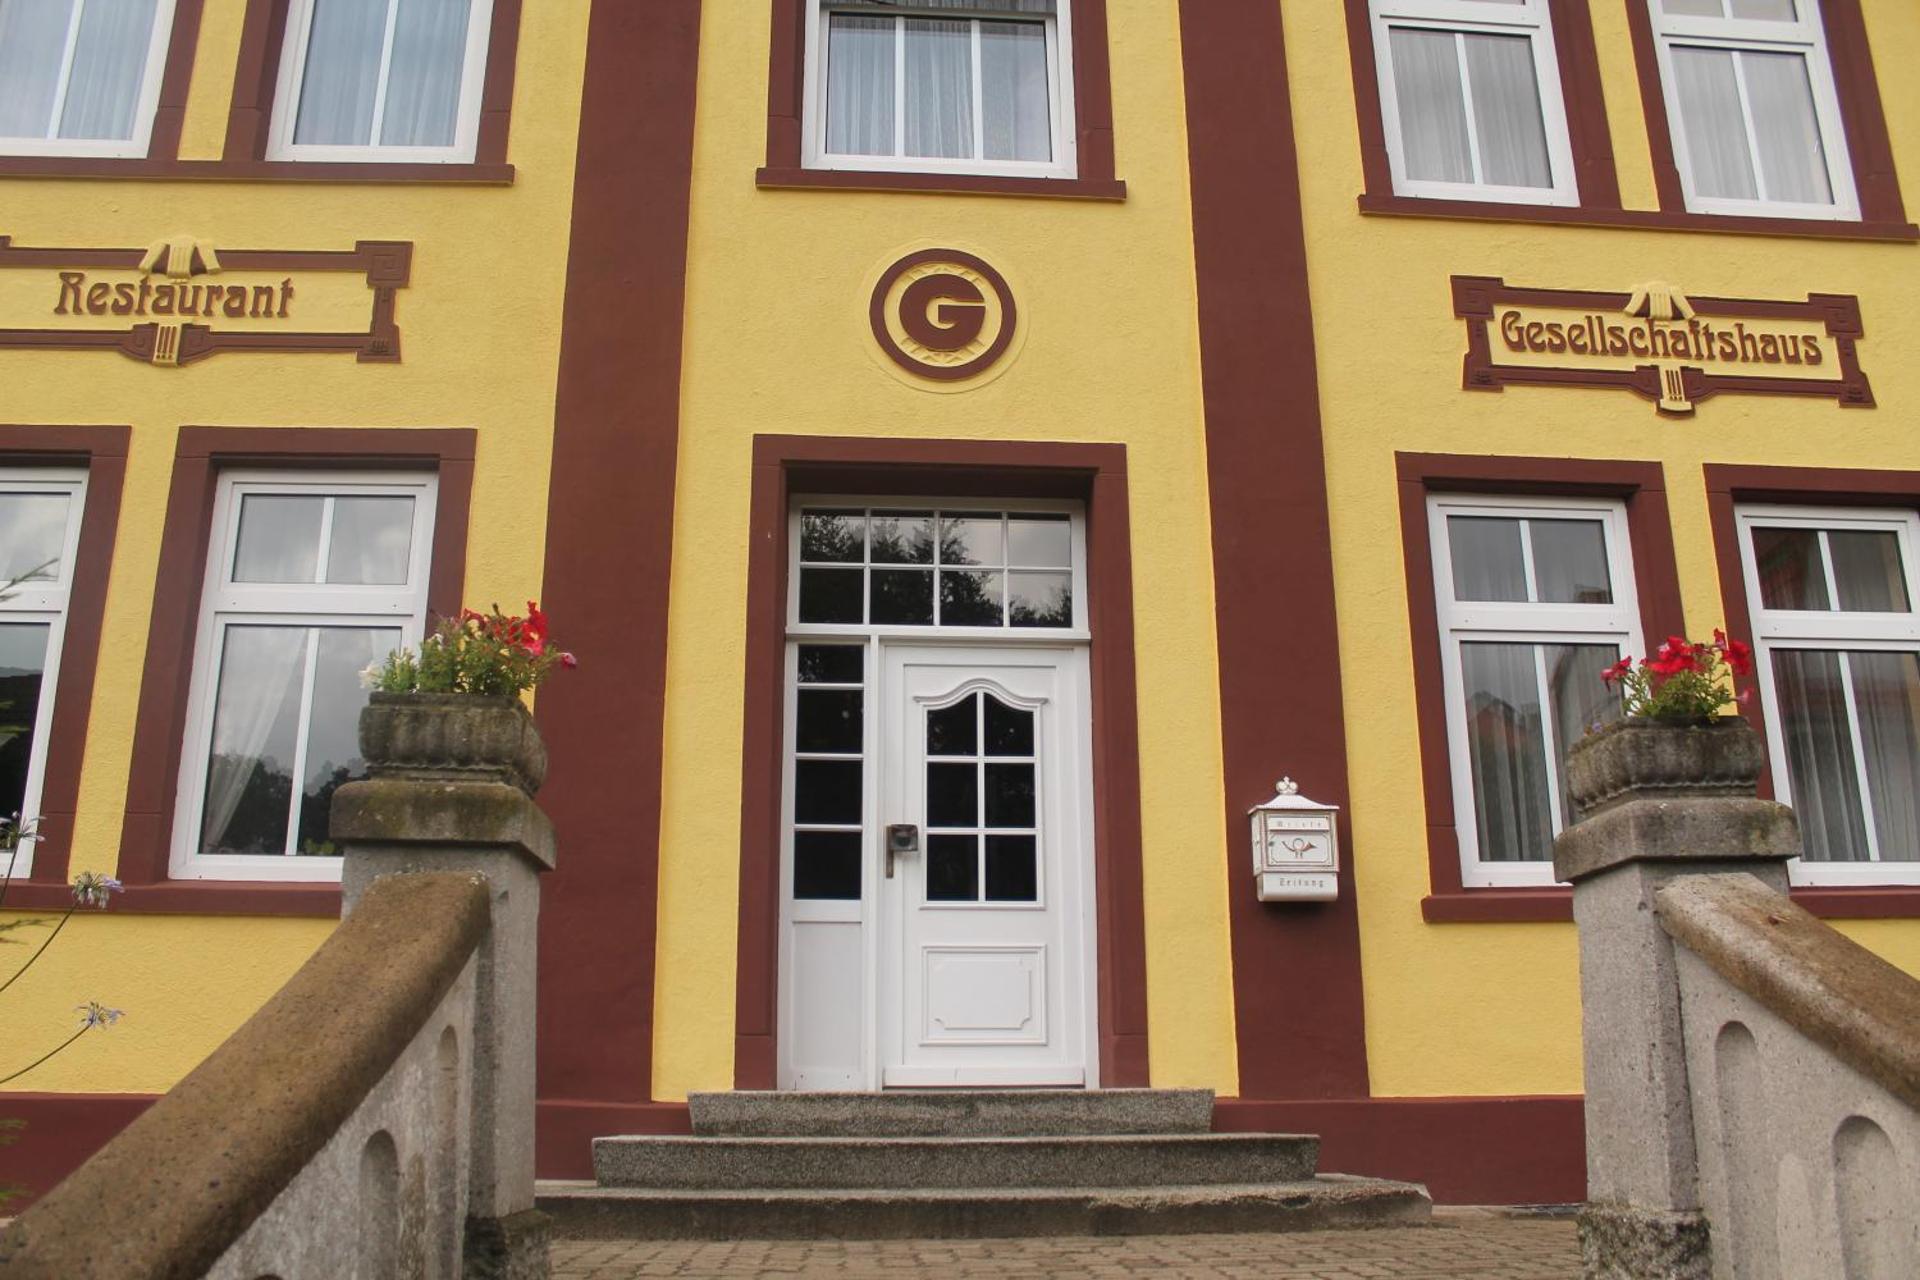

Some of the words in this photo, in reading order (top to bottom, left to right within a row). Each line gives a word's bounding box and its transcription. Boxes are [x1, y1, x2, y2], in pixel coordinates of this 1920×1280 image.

[54, 272, 295, 318] Restaurant
[899, 273, 987, 352] G
[1501, 310, 1824, 365] Gesellschaftshaus
